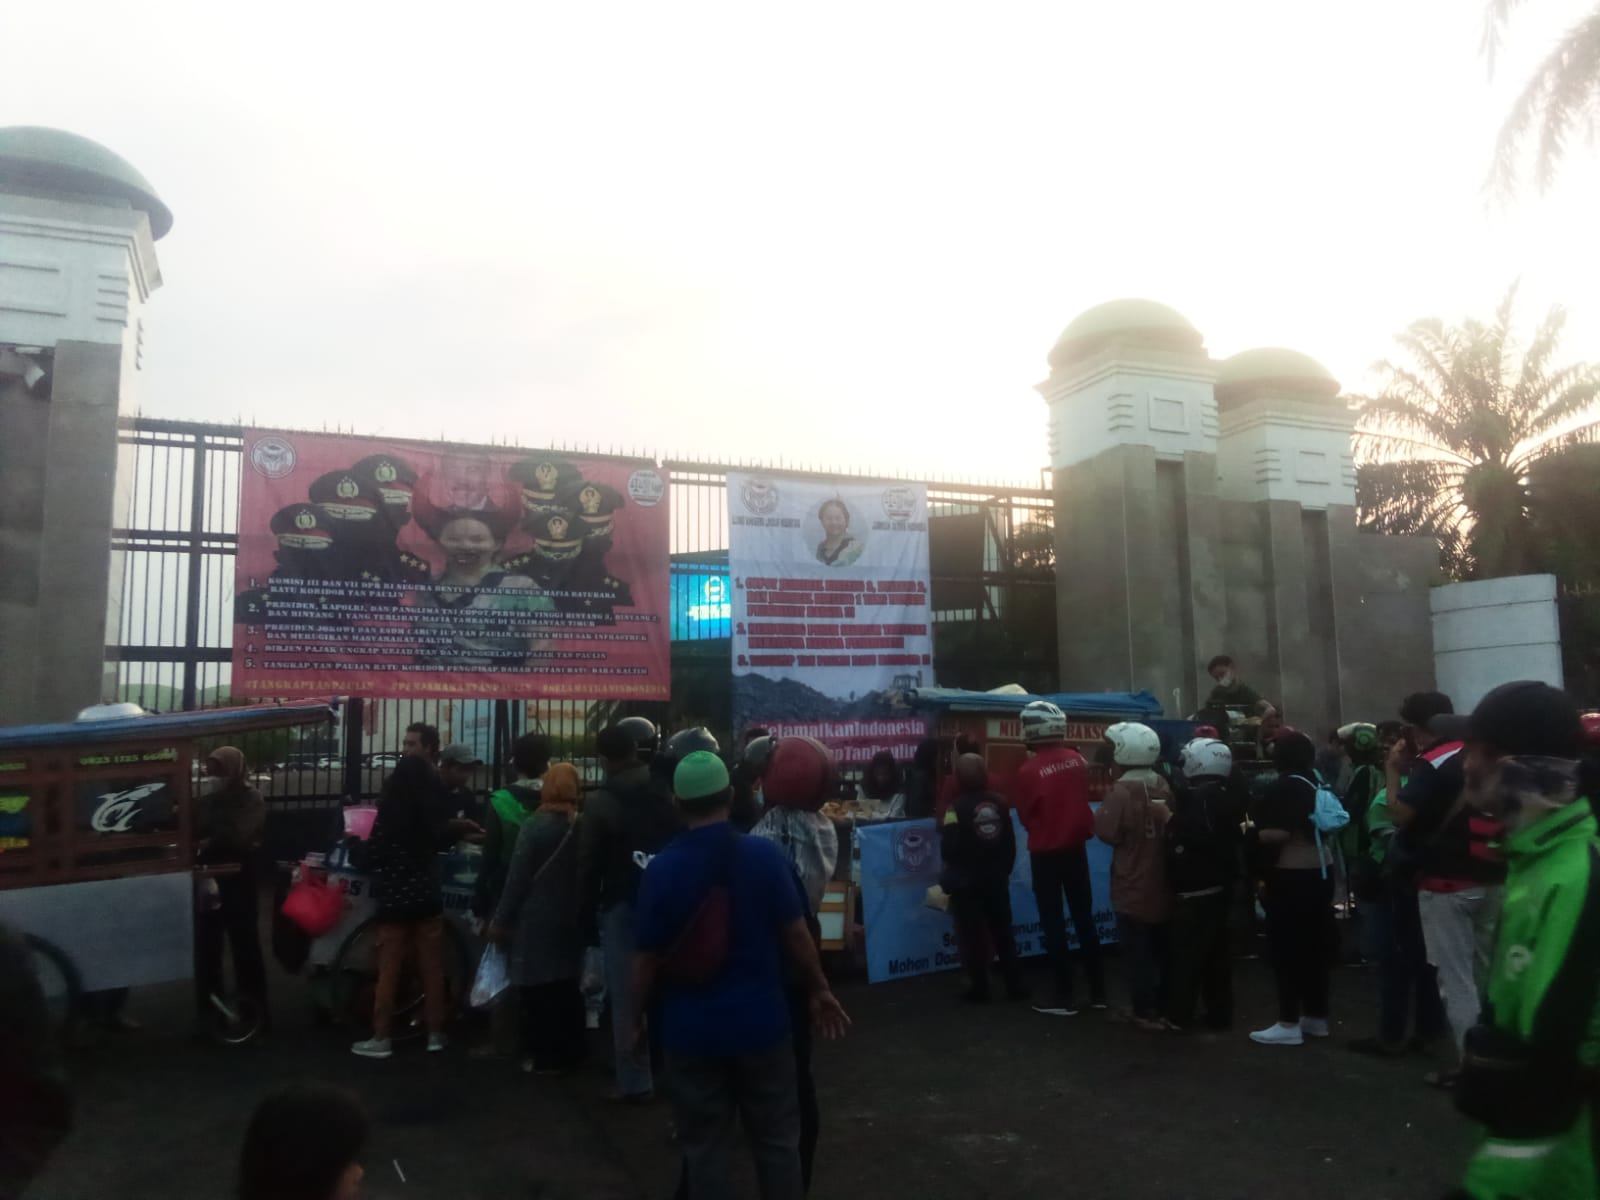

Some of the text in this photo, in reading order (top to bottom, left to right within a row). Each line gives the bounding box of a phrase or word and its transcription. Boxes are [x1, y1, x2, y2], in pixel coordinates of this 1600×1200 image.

[268, 577, 304, 587] KOMISI
[322, 580, 342, 589] DAN
[361, 581, 381, 591] DPR
[543, 590, 569, 598] MAFIA
[270, 586, 405, 600] RATU KORIDOR TAN PAULIN
[268, 610, 289, 618] DAN
[291, 611, 335, 620] BINTANG
[345, 613, 371, 621] YANG
[373, 614, 420, 623] TERLIBAT
[421, 616, 451, 625] MAFIA
[453, 617, 496, 626] TAMBANG
[510, 619, 566, 628] KALIMANTAN
[568, 620, 596, 629] TIMUR
[370, 605, 390, 613] DAN
[392, 606, 440, 616] PANGLIMA
[460, 609, 488, 618] COPOT
[491, 610, 532, 619] PERWIRA
[534, 611, 564, 620] TINGGI
[565, 613, 603, 622] BINTANG
[615, 614, 651, 623] BINTANG
[264, 624, 315, 634] PRESIDEN
[317, 625, 355, 634] JOKOWI
[357, 627, 377, 635] DAN
[459, 630, 476, 639] TAN
[479, 630, 512, 640] PAULIN
[513, 631, 549, 641] KARENA
[552, 632, 593, 642] MERUSAK
[266, 632, 453, 645] DAN MERUGIKAN MASYARAKAT KALTIM
[264, 644, 302, 653] DIRJEN
[304, 645, 338, 654] PAJAK
[339, 646, 380, 655] UNGKAP
[381, 647, 438, 657] KEJAHATAN
[439, 649, 459, 658] DAN
[461, 650, 524, 660] PENGGELAPAN
[525, 651, 554, 660] PAJAK
[263, 661, 311, 670] TANGKAP
[313, 662, 332, 671] TAN
[334, 662, 371, 671] PAULIN
[373, 663, 399, 672] RATU
[401, 664, 444, 673] KORIDOR
[532, 666, 564, 675] PETANI
[616, 667, 647, 676] KALTIM
